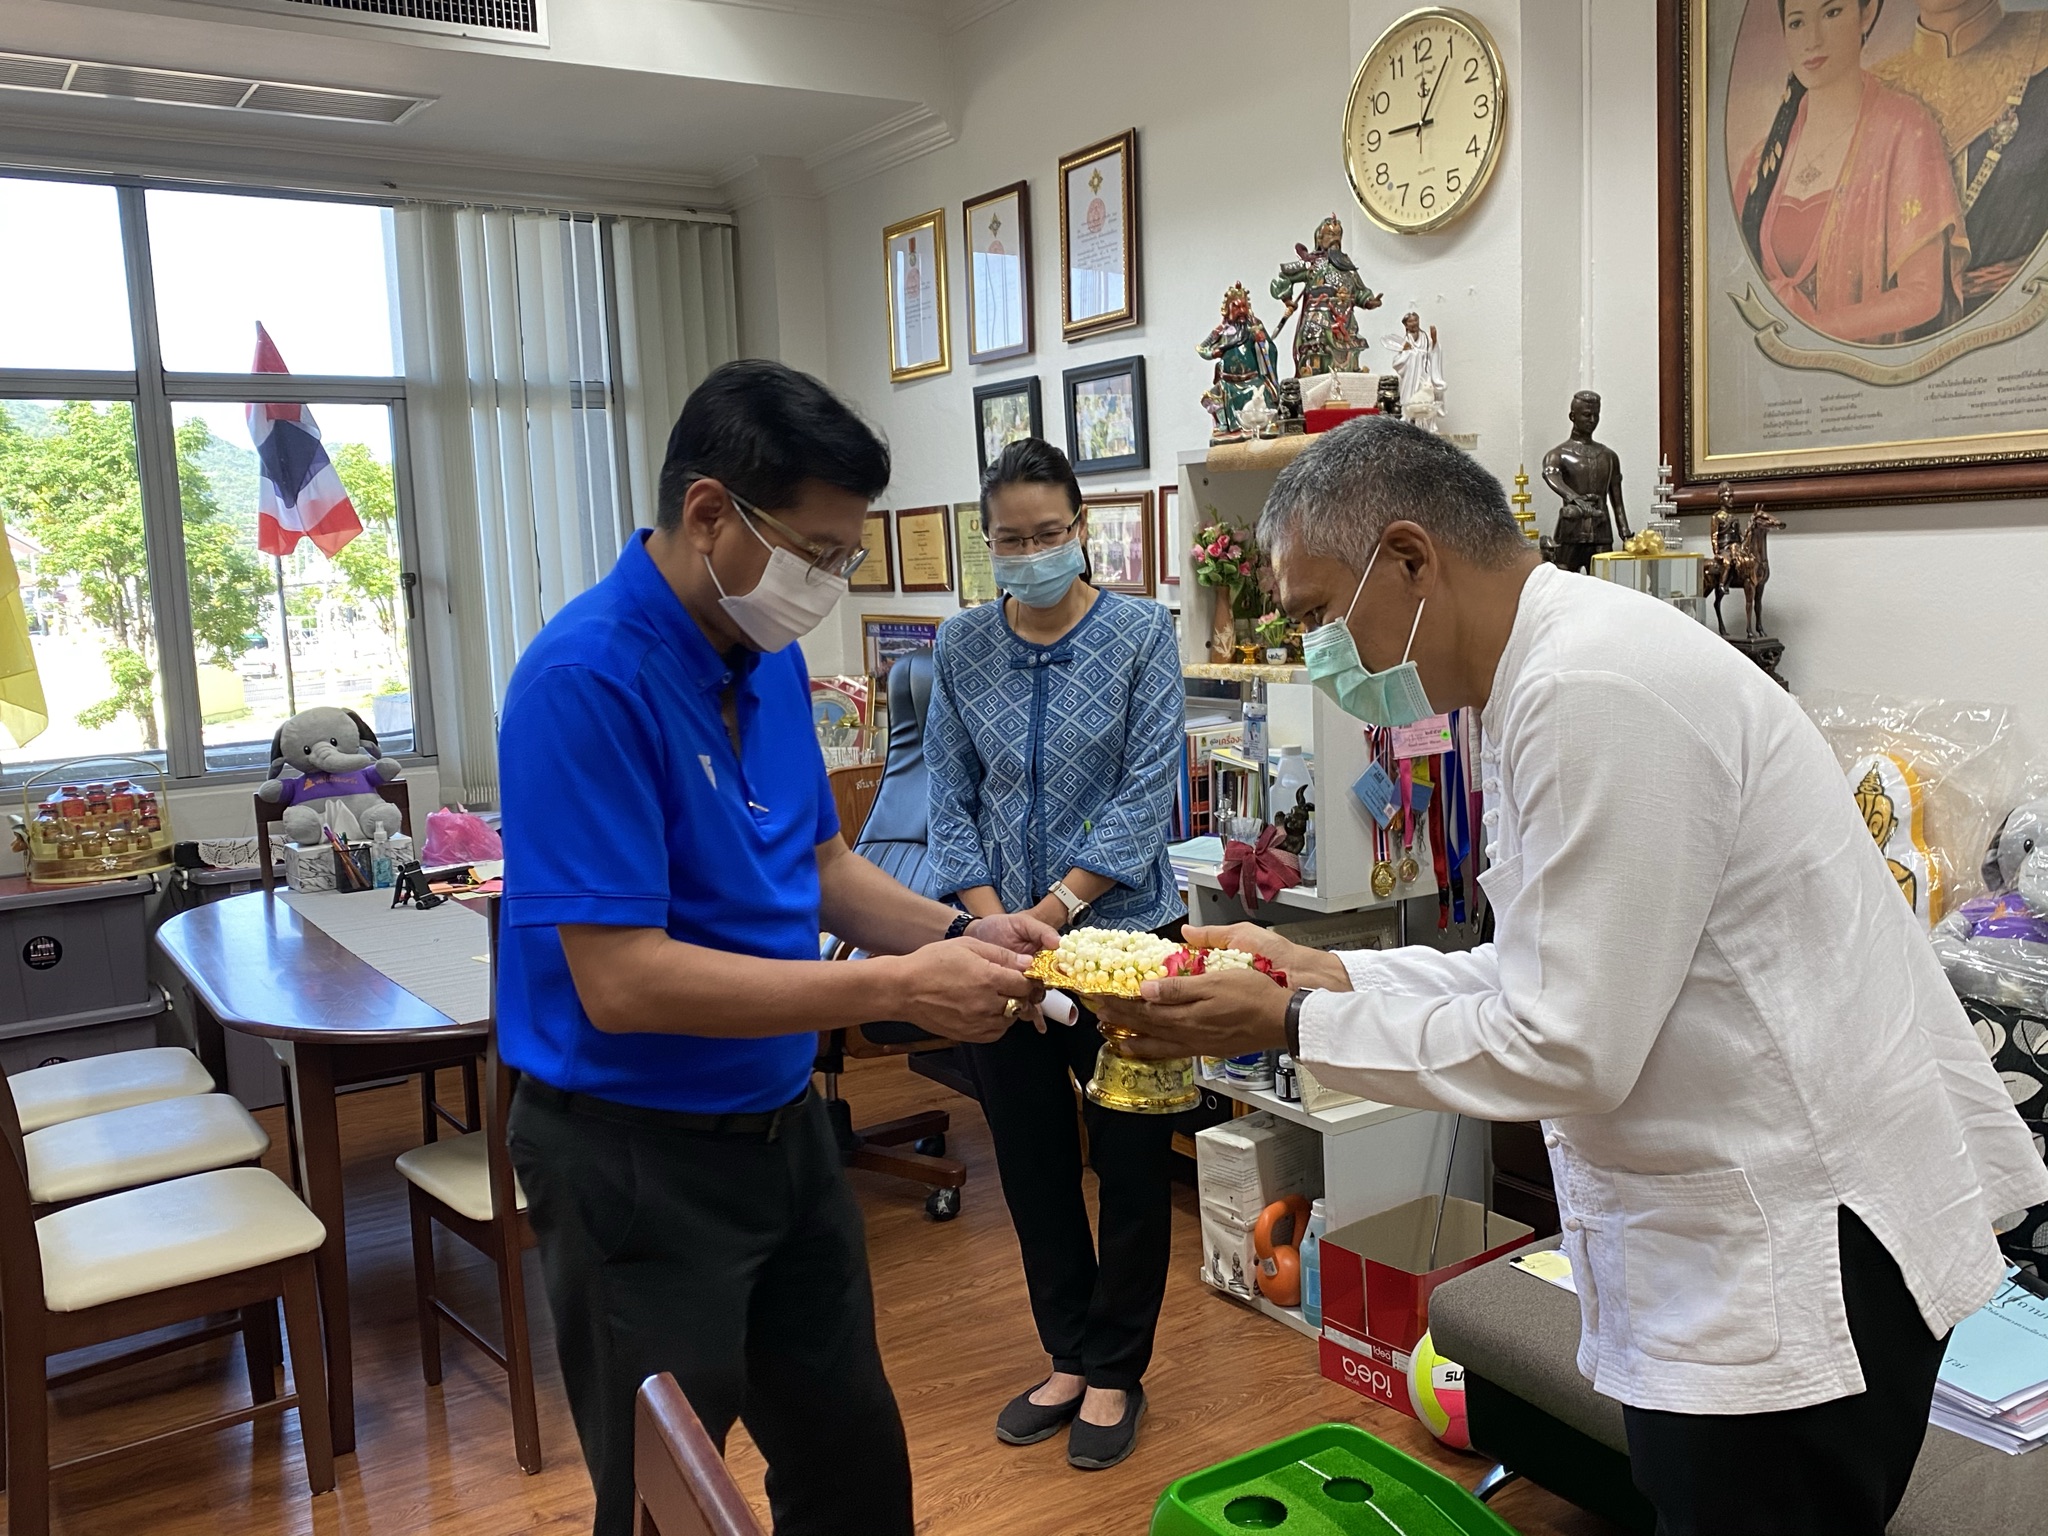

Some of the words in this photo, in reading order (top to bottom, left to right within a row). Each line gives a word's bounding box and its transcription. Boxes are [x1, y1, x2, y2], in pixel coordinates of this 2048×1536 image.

[1413, 37, 1432, 64] 12
[1447, 35, 1454, 59] 1
[1390, 54, 1404, 80] 11
[1464, 57, 1479, 84] 2
[1370, 91, 1390, 116] 10
[1473, 94, 1489, 119] 3
[1367, 129, 1381, 153] 9
[1465, 134, 1481, 158] 4
[1375, 162, 1389, 186] 8
[1446, 168, 1460, 192] 5
[1396, 183, 1410, 207] 7
[1420, 185, 1435, 209] 6
[1342, 1355, 1393, 1399] idea
[1445, 1371, 1465, 1382] SU
